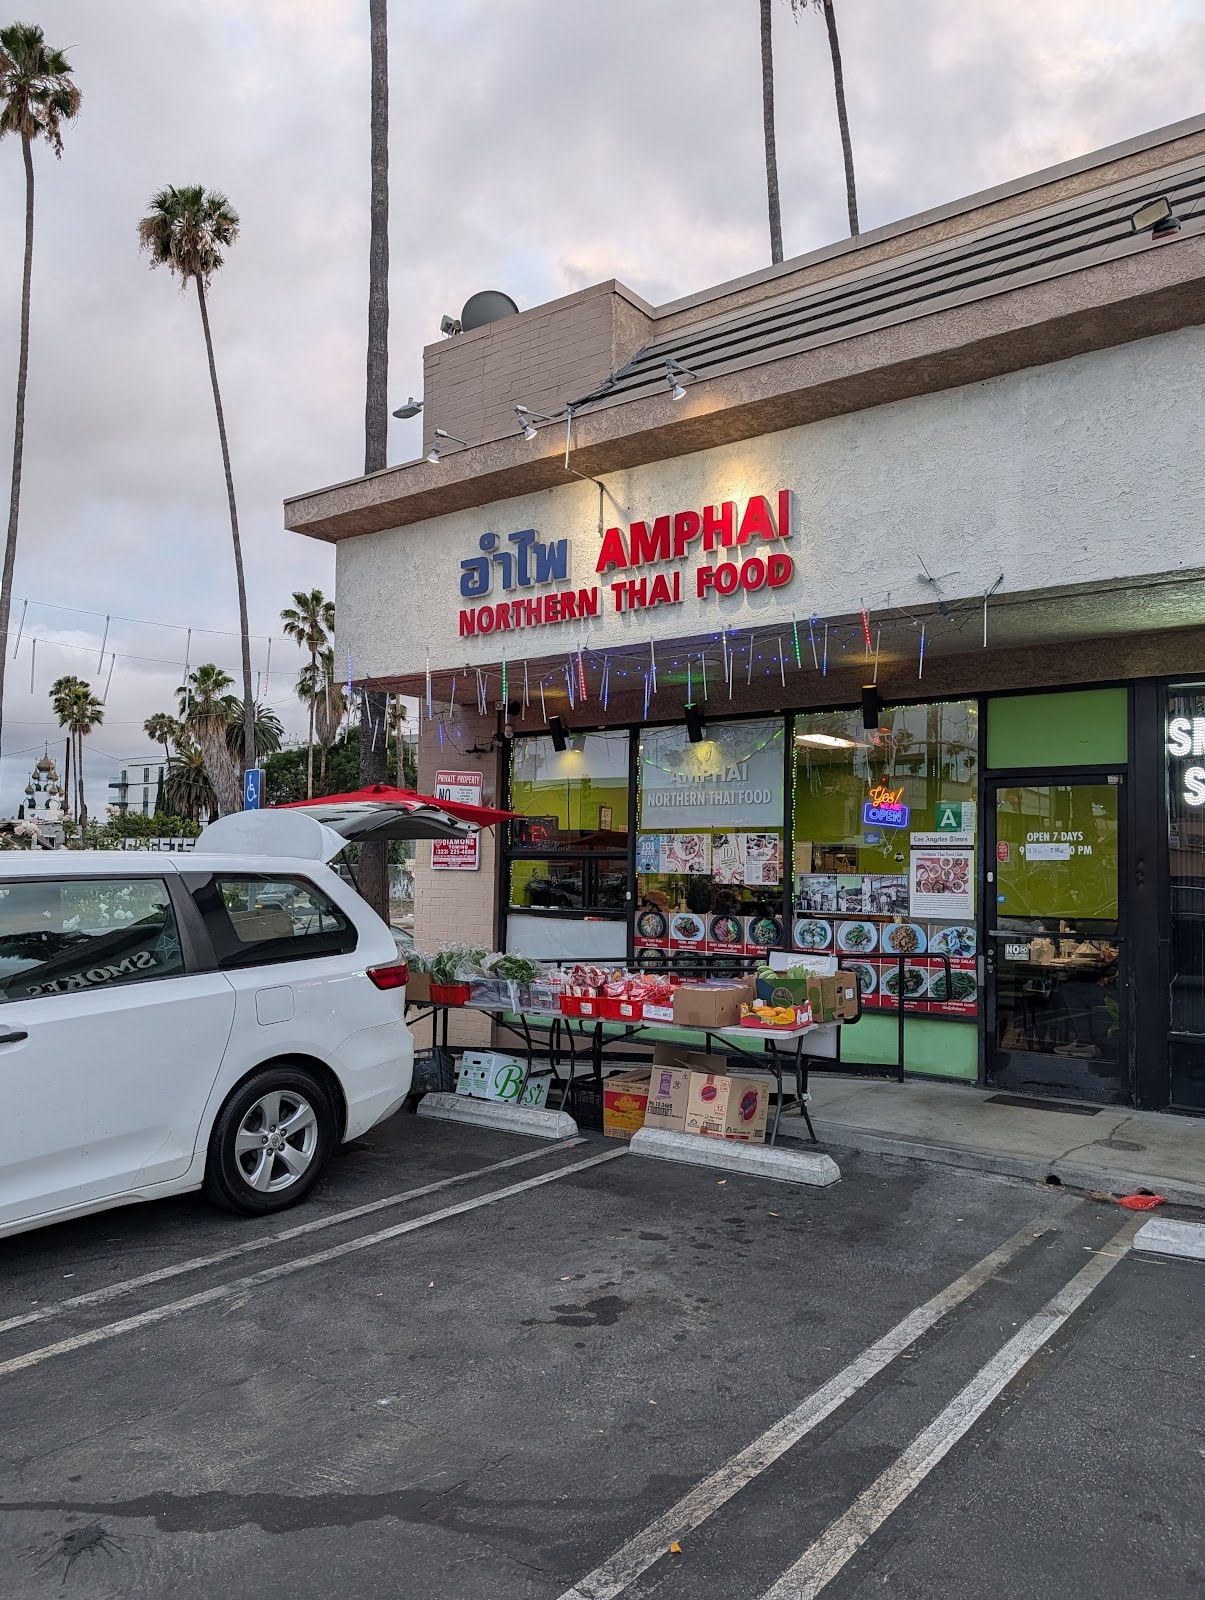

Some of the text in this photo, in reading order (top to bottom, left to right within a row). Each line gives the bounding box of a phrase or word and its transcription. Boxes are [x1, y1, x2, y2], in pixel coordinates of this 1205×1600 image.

[595, 489, 793, 573] AMPHAI
[460, 528, 568, 597] อำไพ
[459, 553, 794, 636] NORTHERN THAI FOOD
[438, 774, 480, 785] PRIVATE PROPERTY
[670, 762, 748, 784] AMPHAI
[439, 787, 451, 801] NO
[648, 789, 772, 807] NORTHERN THAI FOOD
[869, 808, 902, 822] OPEN
[940, 808, 957, 827] A
[913, 835, 968, 844] Los Angeles Times
[1027, 831, 1083, 841] OPEN 7 DAYS
[641, 842, 655, 850] 101
[1077, 845, 1093, 855] PM
[1007, 945, 1020, 954] NO
